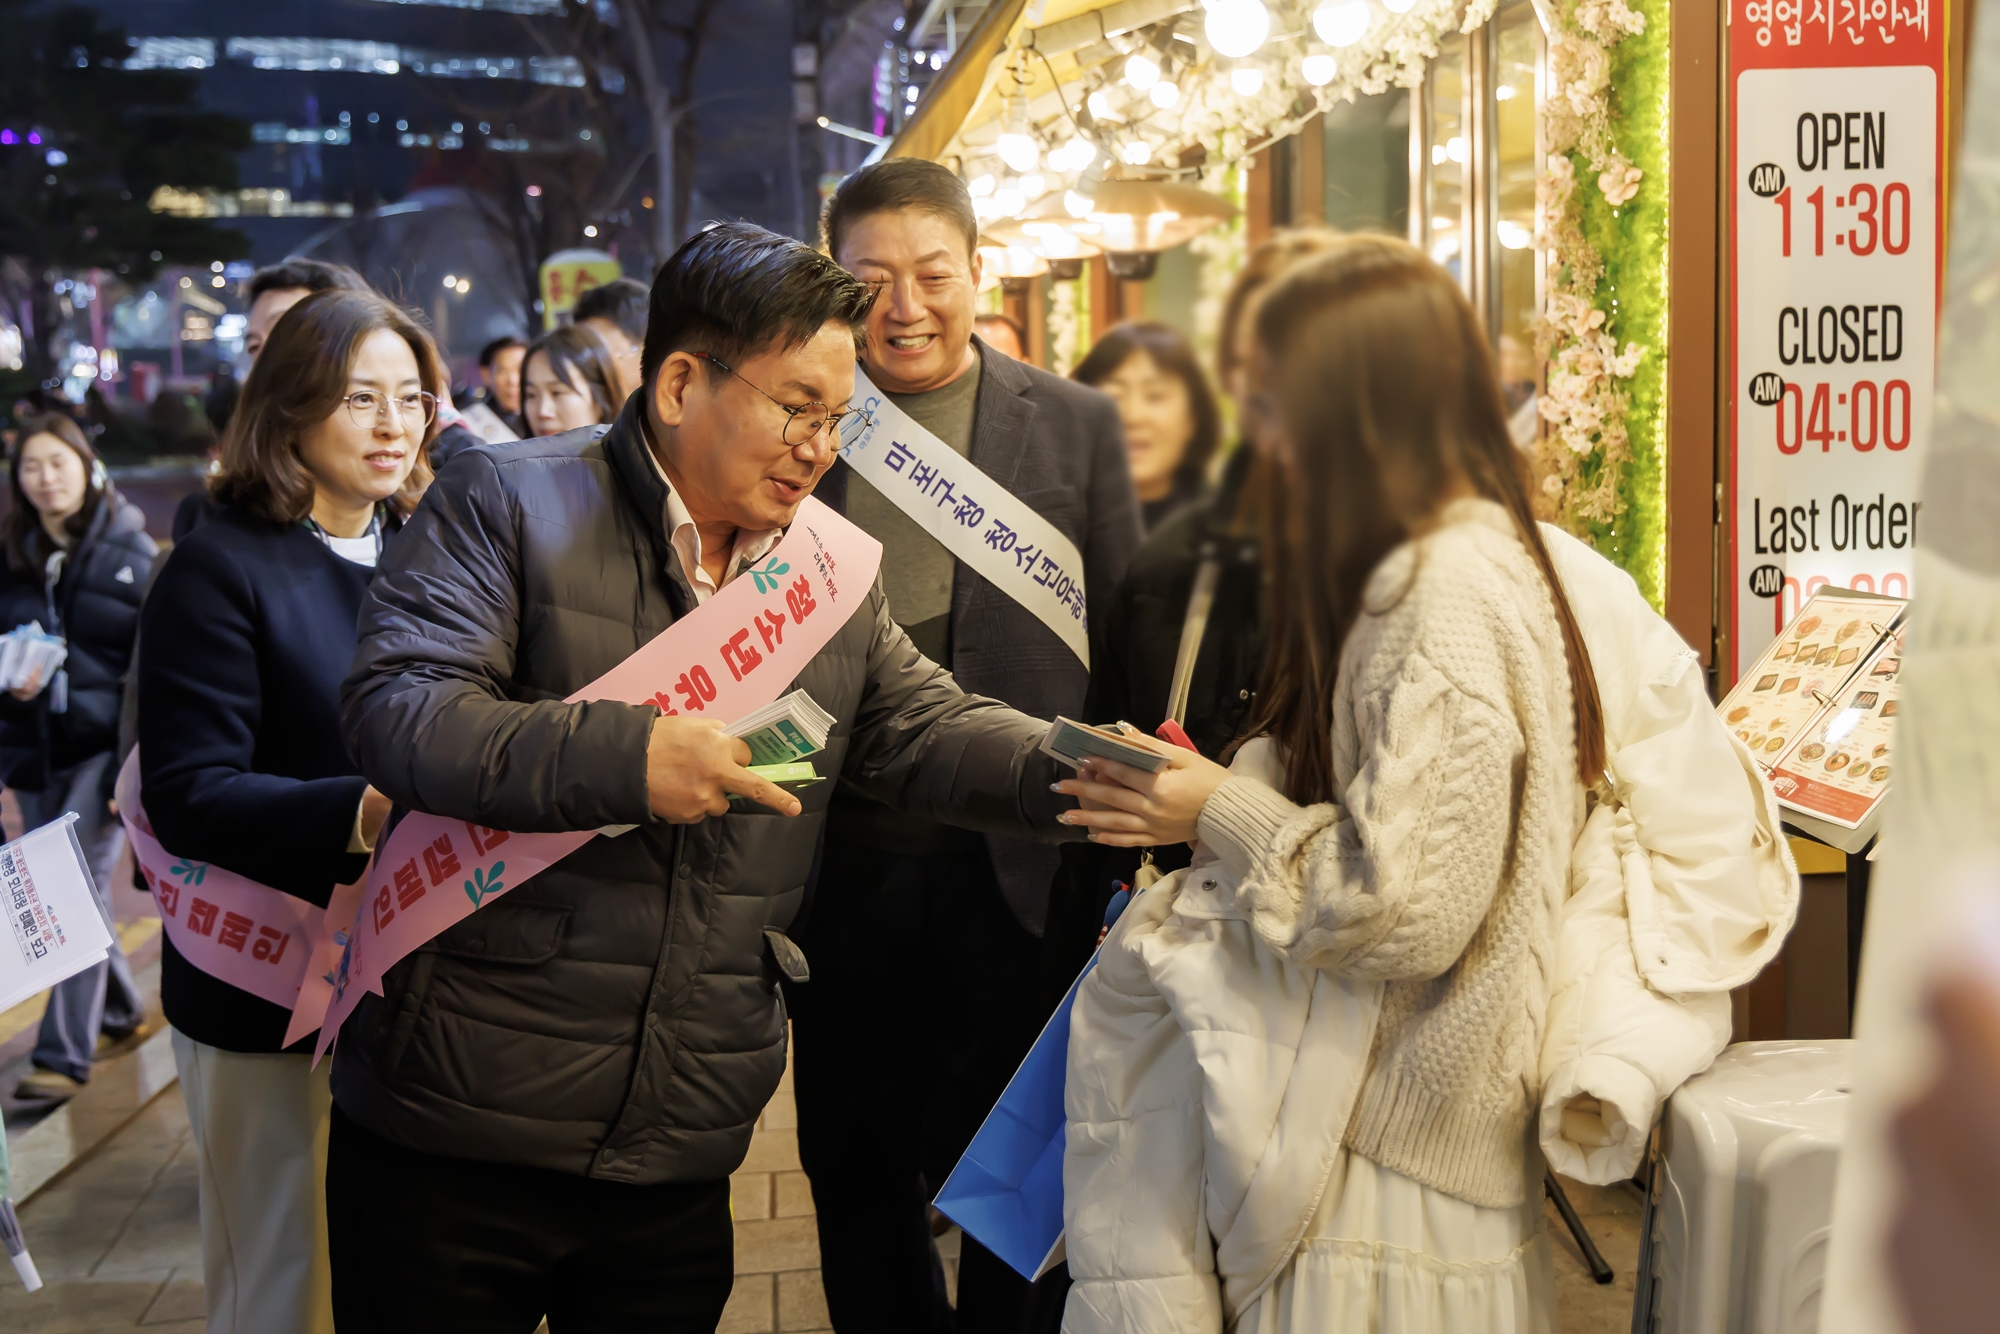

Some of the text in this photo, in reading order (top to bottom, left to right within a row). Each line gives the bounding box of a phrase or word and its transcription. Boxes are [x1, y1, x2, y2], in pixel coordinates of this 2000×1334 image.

[1745, 0, 1930, 47] 영업시간안내
[1796, 111, 1886, 172] OPEN
[1753, 166, 1782, 192] AM
[1774, 182, 1911, 258] 11:30
[1778, 304, 1903, 365] CLOSED
[1753, 376, 1782, 402] AM
[1776, 380, 1911, 455] 04:00
[884, 440, 986, 528] 마포구청
[1754, 493, 1921, 554] Last Order
[1753, 568, 1782, 593] AM
[719, 573, 818, 683] 청소년
[372, 832, 462, 937] 캠페인
[187, 896, 291, 966] 캠페인
